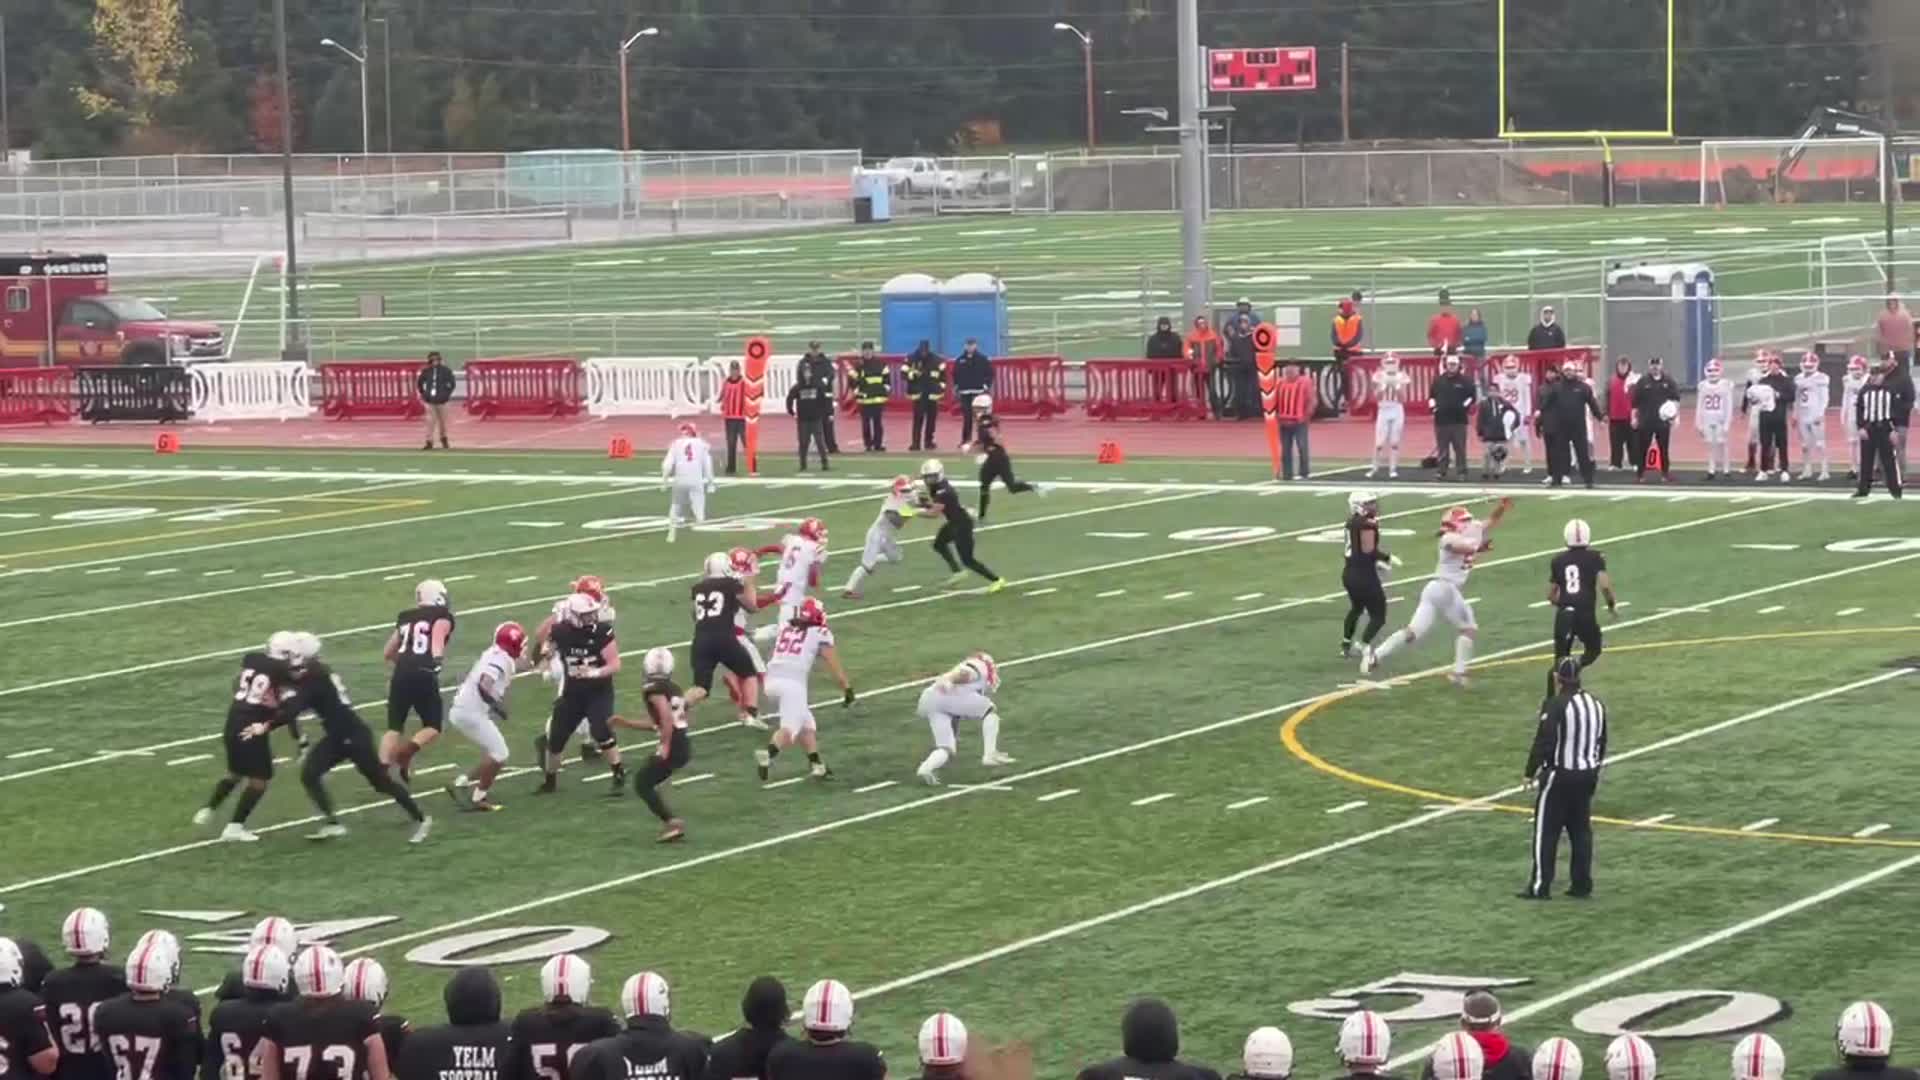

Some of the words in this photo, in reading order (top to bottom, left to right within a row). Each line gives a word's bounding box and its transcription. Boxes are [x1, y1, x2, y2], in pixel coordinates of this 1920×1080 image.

[685, 443, 694, 463] 4
[1564, 564, 1581, 594] 8
[695, 591, 725, 621] 63
[398, 621, 431, 654] 76
[108, 1034, 161, 1080] 67
[283, 1044, 356, 1080] 73
[453, 1046, 496, 1068] YELM
